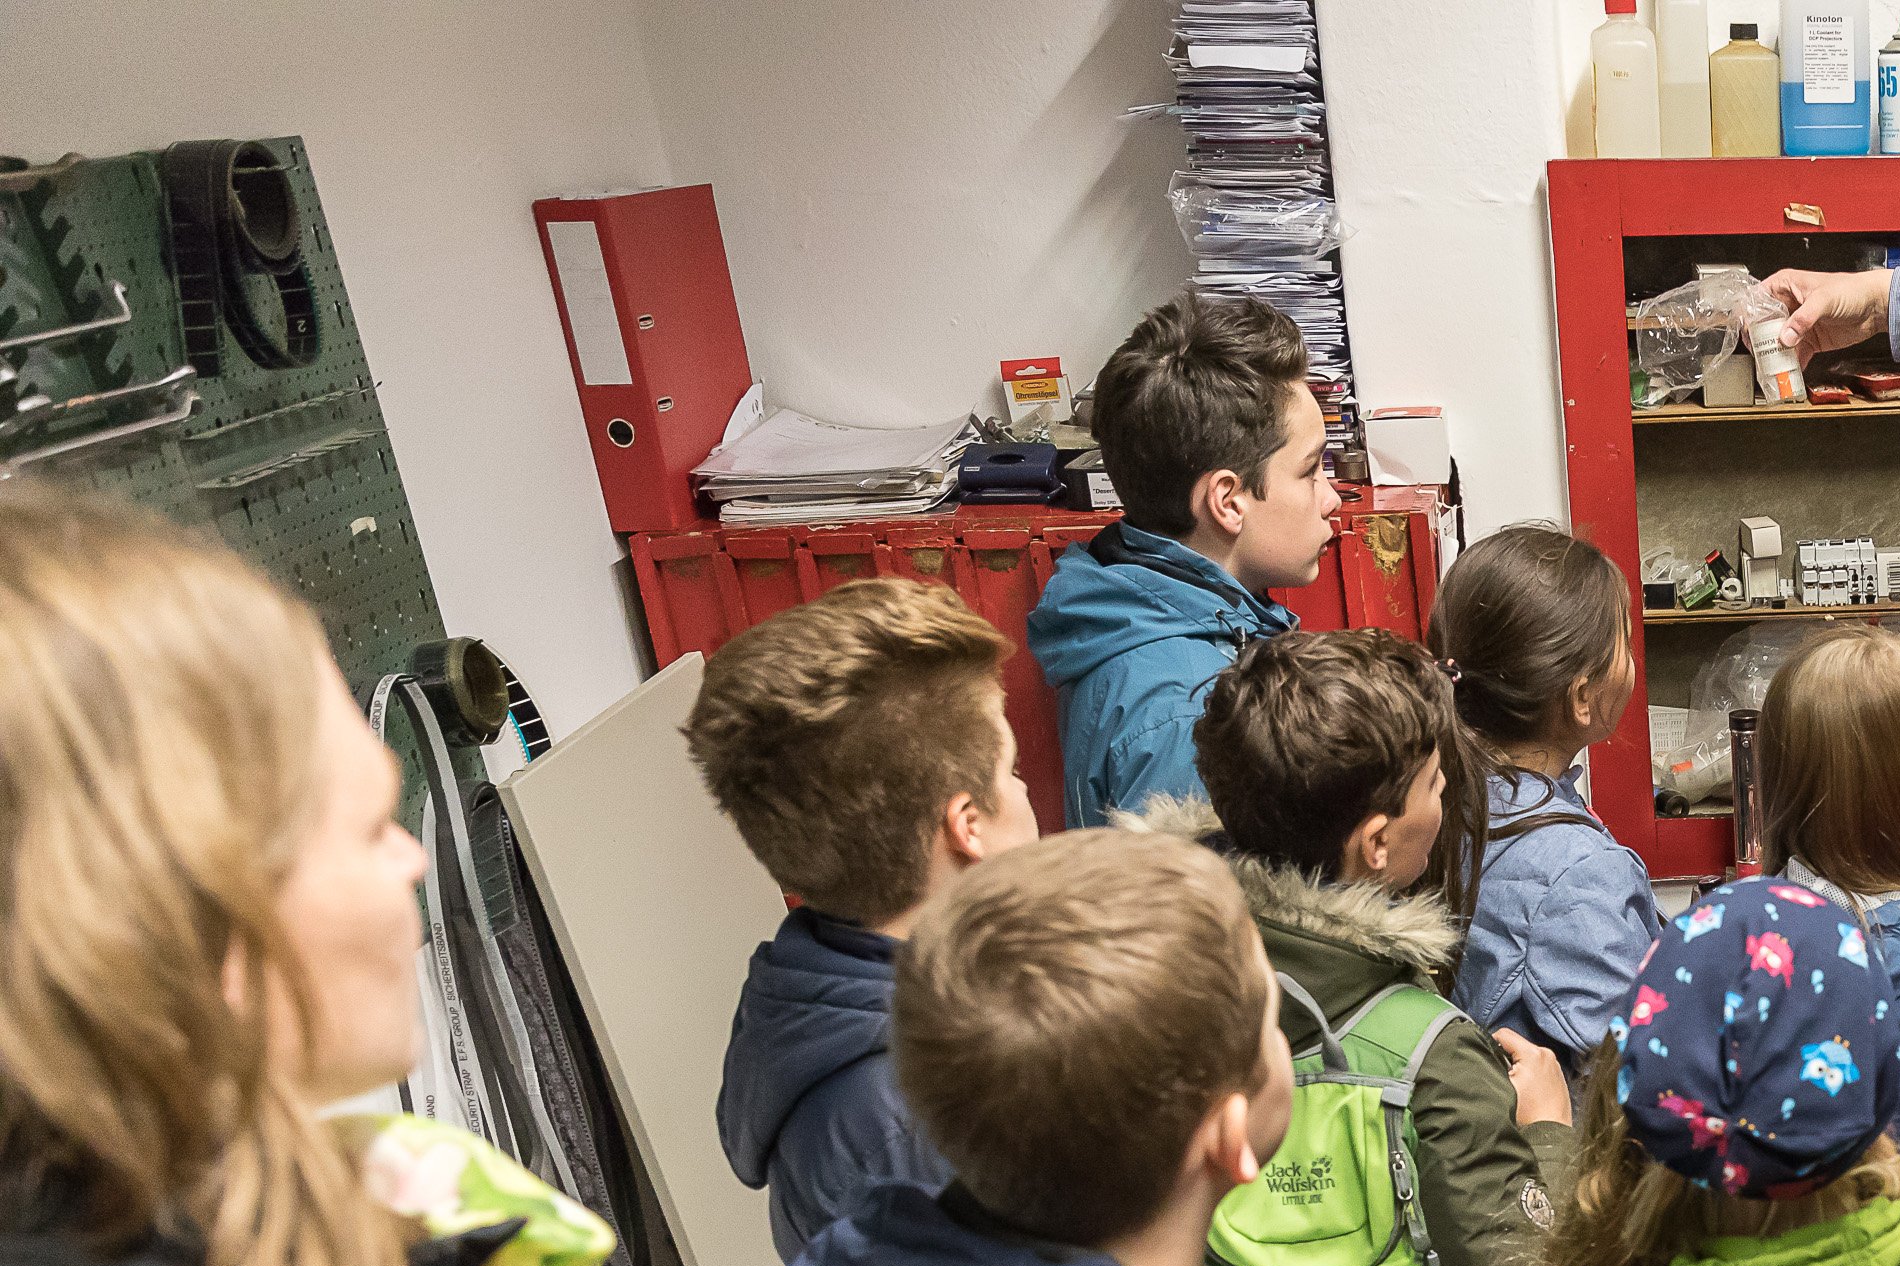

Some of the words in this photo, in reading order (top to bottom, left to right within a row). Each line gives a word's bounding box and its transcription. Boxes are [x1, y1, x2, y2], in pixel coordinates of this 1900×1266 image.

[1806, 15, 1843, 23] Kinoton
[433, 922, 456, 1001] SICHERHEITSBAND
[461, 1068, 475, 1096] STRAP
[1266, 1162, 1302, 1177] Jack
[1266, 1176, 1336, 1192] Wolfskin
[1282, 1195, 1306, 1205] LITTLE
